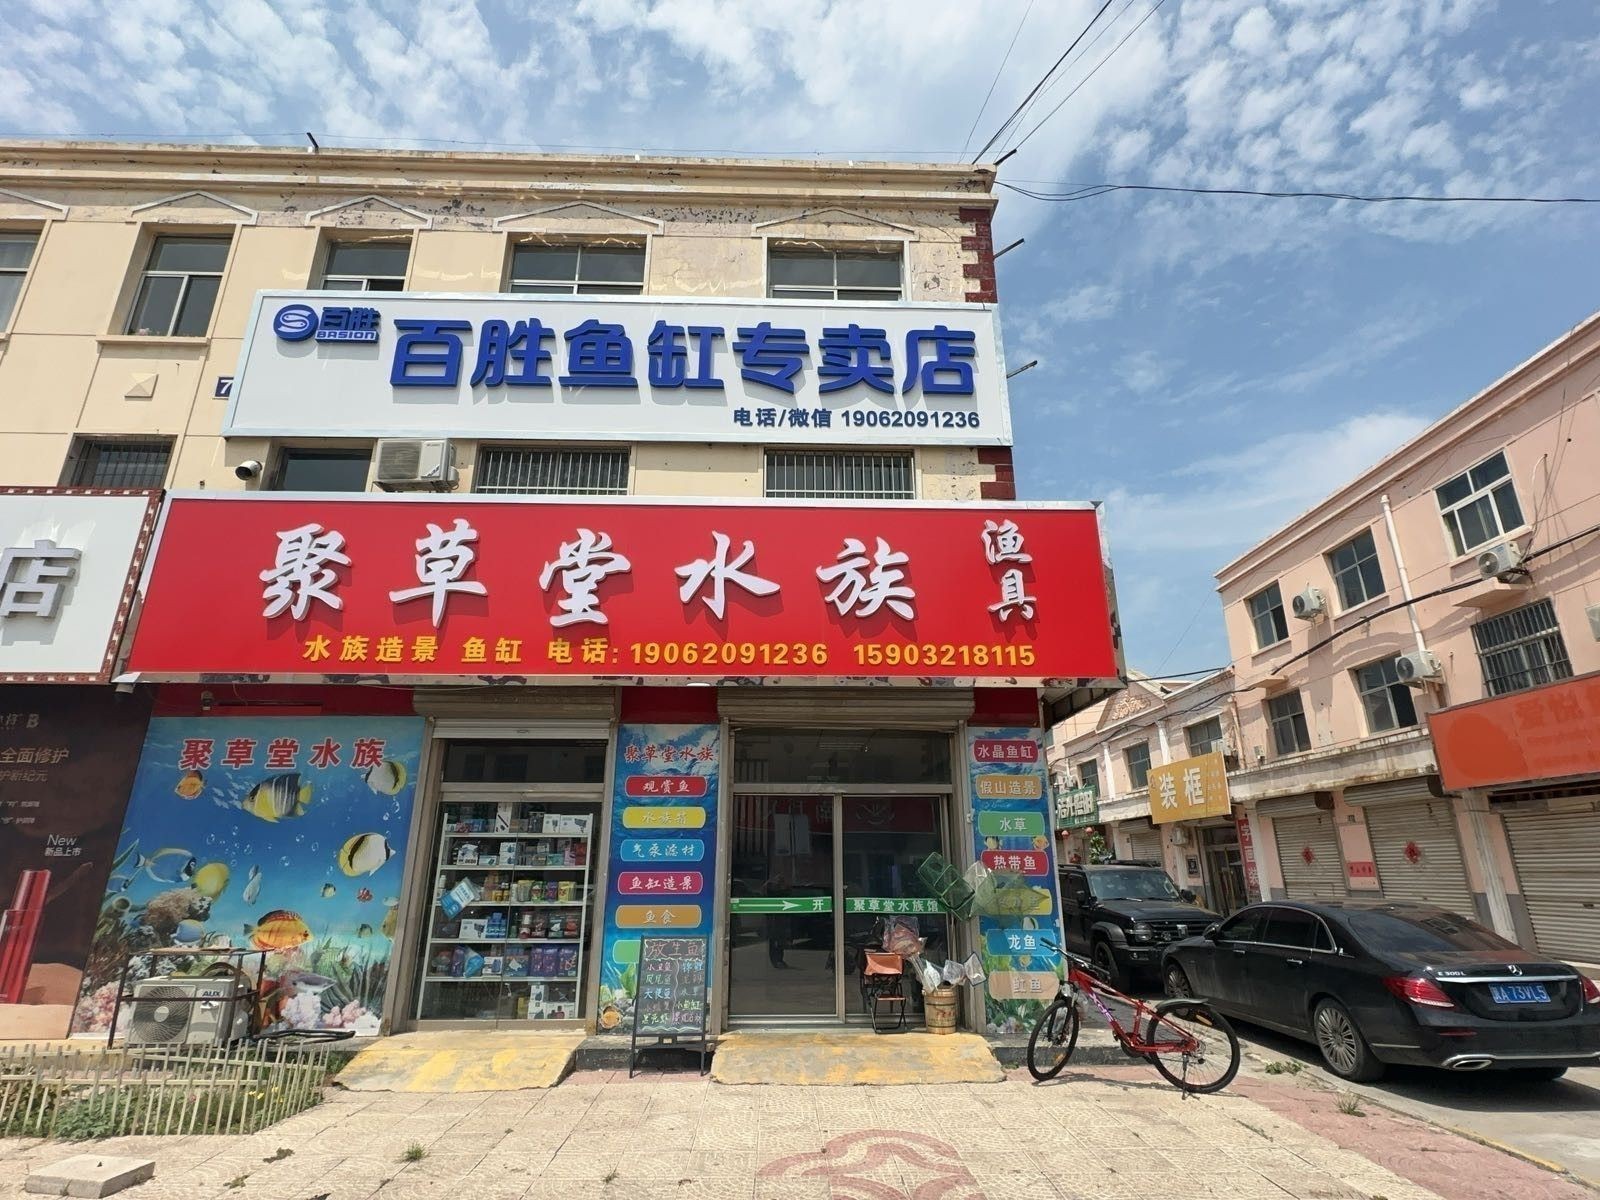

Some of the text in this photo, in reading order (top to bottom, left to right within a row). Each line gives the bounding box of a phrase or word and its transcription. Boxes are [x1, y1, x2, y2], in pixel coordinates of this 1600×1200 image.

[321, 306, 381, 331] 百胜
[390, 318, 976, 395] 百胜鱼缸专卖店
[733, 407, 980, 428] 电话/微信 19062091236
[259, 518, 916, 629] 聚草堂水族
[981, 519, 1038, 623] 渔具
[302, 634, 439, 664] 水族造景
[461, 637, 522, 664] 鱼缸
[630, 642, 828, 666] 19062091236
[853, 644, 1035, 667] 15903218115
[178, 738, 385, 770] 聚草堂水族
[624, 743, 714, 764] 聚草堂水族
[977, 744, 1034, 759] 水晶鱼缸
[642, 780, 691, 794] 观赏鱼
[980, 780, 1037, 796] 假山造景
[1158, 767, 1205, 810] 装框
[1000, 817, 1027, 832] 水草
[47, 834, 77, 846] New
[993, 855, 1037, 870] 热带鱼
[629, 875, 693, 891] 鱼缸造景
[812, 899, 825, 911] 开
[853, 899, 939, 912] 聚草堂水族馆
[643, 909, 677, 925] 鱼食
[1008, 934, 1037, 950] 龙鱼
